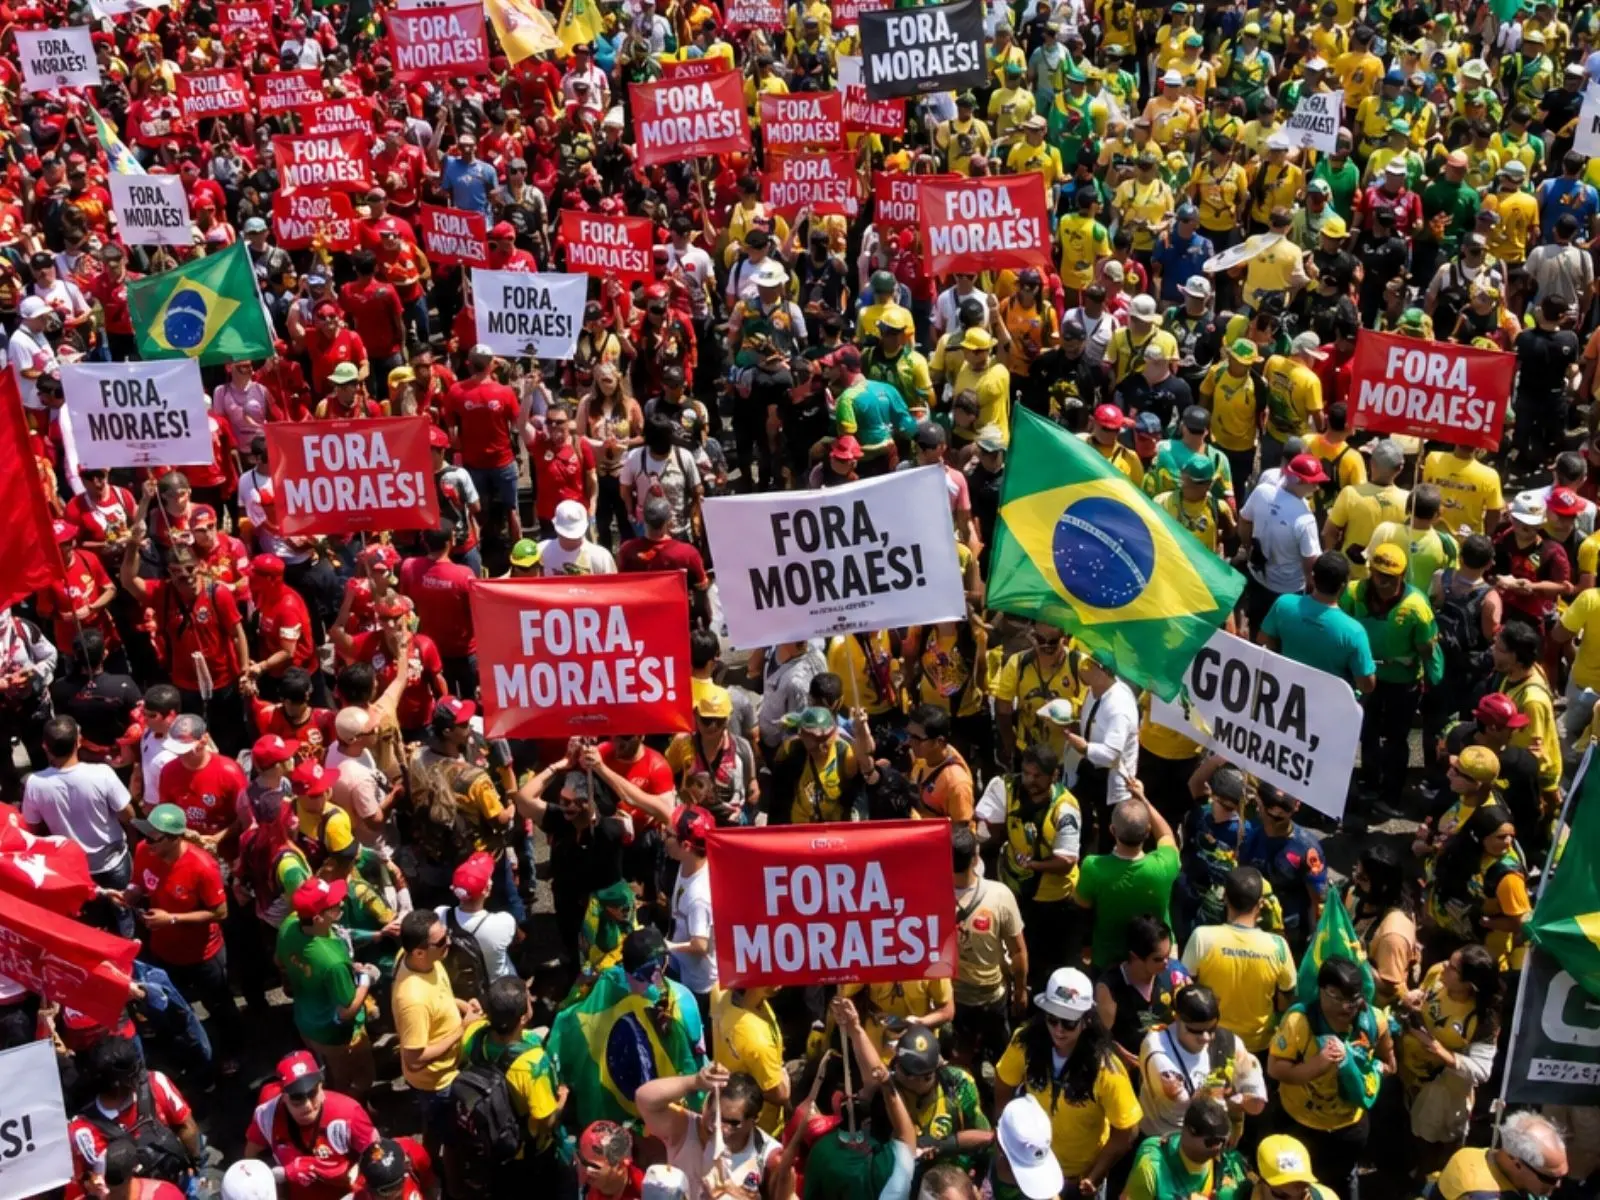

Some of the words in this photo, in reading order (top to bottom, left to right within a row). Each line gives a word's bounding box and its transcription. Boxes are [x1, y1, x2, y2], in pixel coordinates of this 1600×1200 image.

[407, 14, 467, 42] FORA,
[887, 10, 959, 48] FORA,
[31, 55, 87, 75] MORAES!
[396, 37, 484, 70] MORAES!
[871, 40, 980, 84] MORAES!
[654, 81, 723, 116] FORA,
[777, 100, 827, 121] FORA,
[641, 108, 742, 148] MORAES!
[767, 121, 840, 144] MORAES!
[292, 138, 349, 163] FORA,
[284, 159, 365, 187] MORAES!
[783, 158, 838, 181] FORA,
[770, 177, 853, 208] MORAES!
[891, 181, 919, 200] FO
[945, 185, 1021, 221] FORA,
[123, 207, 184, 228] MORAES!
[879, 200, 920, 222] MOR
[580, 220, 634, 248] FORA,
[928, 217, 1042, 257] MORAES!
[568, 243, 650, 272] MORAES!
[503, 285, 558, 312] FORA,
[488, 310, 573, 338] MORAES!
[1386, 345, 1477, 397] FORA,
[99, 378, 168, 409] FORA,
[1357, 379, 1496, 433] MORAES!
[88, 409, 191, 441] MORAES!
[302, 431, 400, 473] FORA,
[283, 471, 427, 515] MORAES!
[770, 500, 889, 556] FORA,
[748, 544, 926, 610] MORAES!
[519, 605, 645, 657] FORA,
[493, 656, 677, 708] MORAES!
[1191, 647, 1320, 752] GORA,
[1213, 716, 1314, 786] MORAES!
[763, 861, 905, 916] FORA,
[732, 915, 941, 973] MORAES!
[0, 1114, 36, 1159] S!
